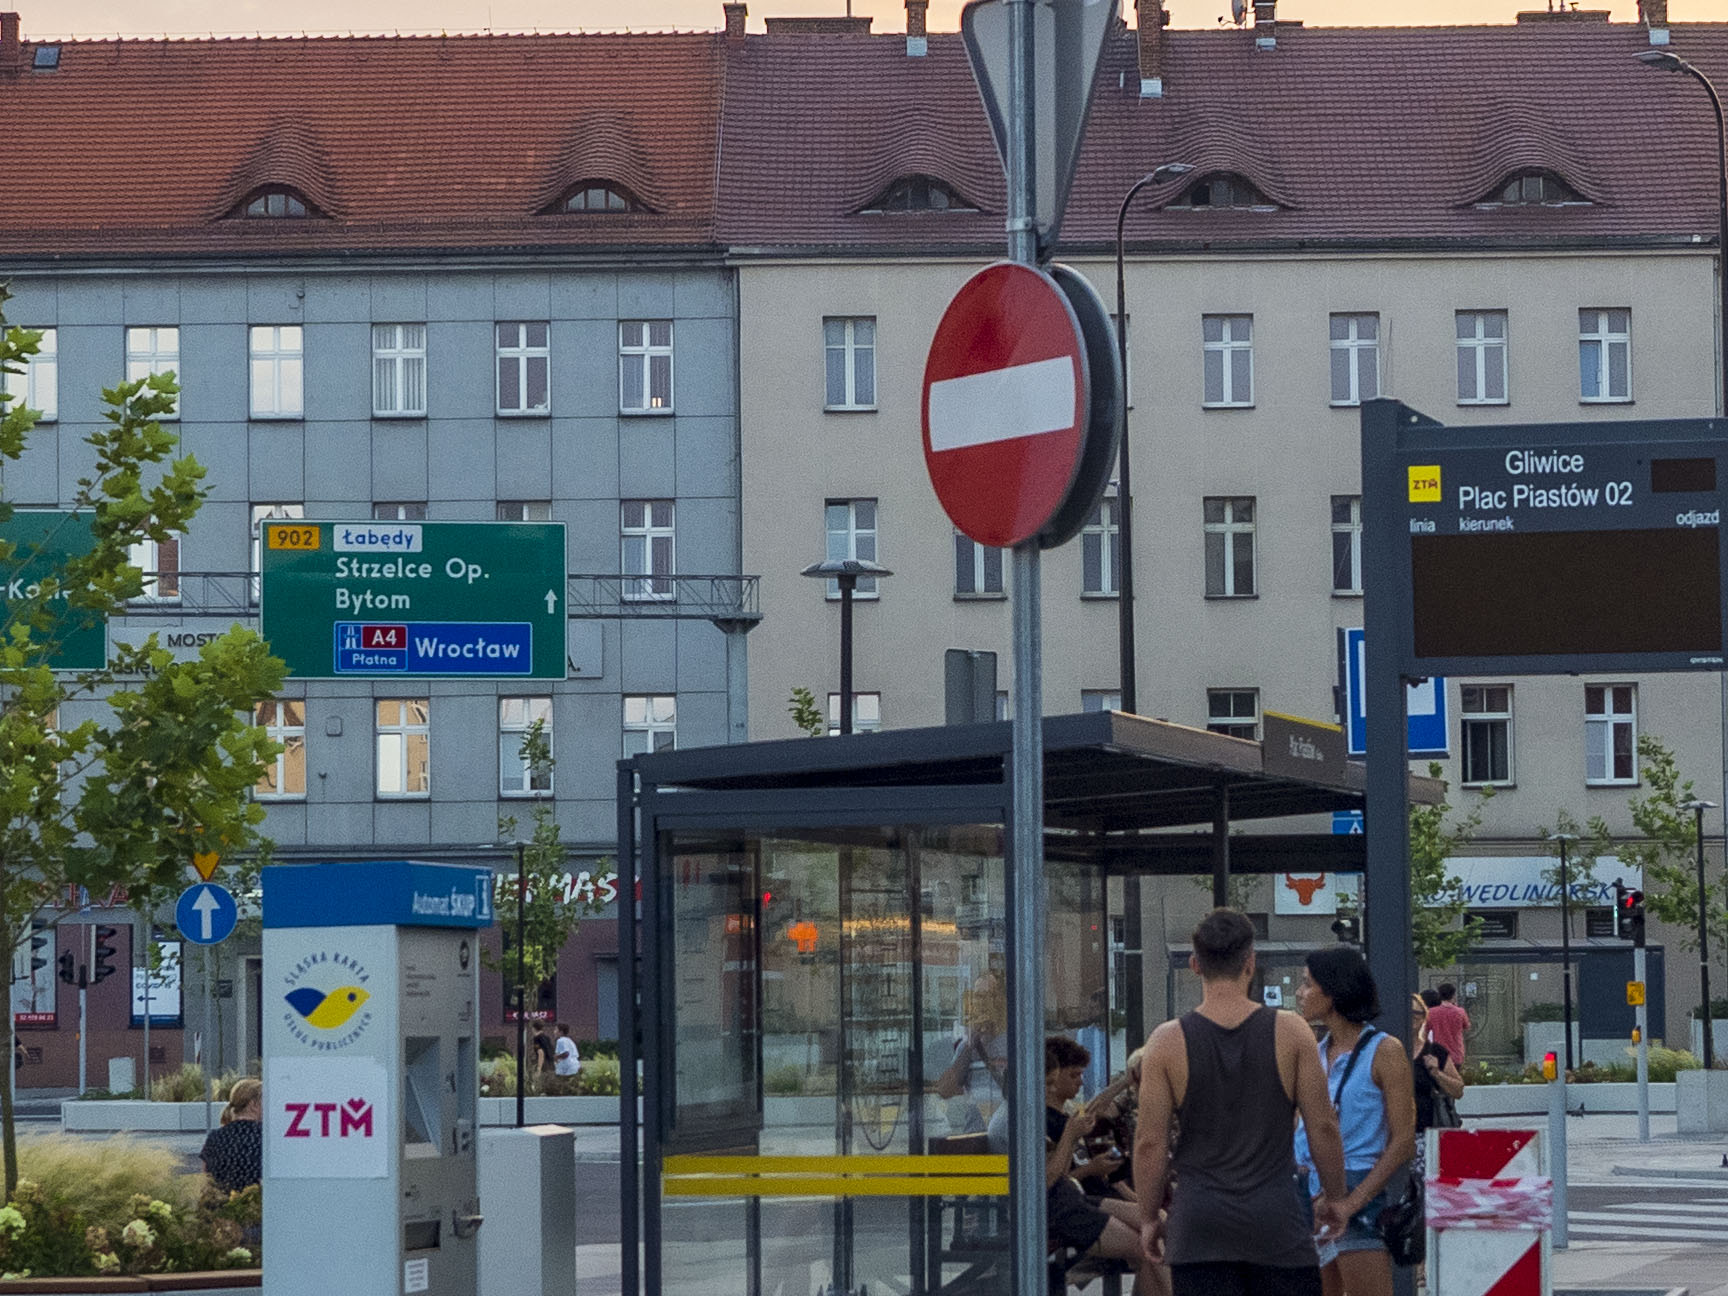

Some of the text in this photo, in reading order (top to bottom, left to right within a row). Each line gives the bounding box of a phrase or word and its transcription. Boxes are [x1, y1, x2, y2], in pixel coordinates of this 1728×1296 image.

[1505, 450, 1584, 475] Gliwice
[1458, 482, 1633, 510] Plac Piastów 02
[1410, 509, 1720, 533] linia kierunek odjazd
[277, 528, 414, 550] 902 Łabędy
[335, 557, 490, 584] Strzelce Op.
[335, 588, 411, 615] Bytom
[371, 629, 398, 646] A4
[415, 637, 520, 659] Wrocław
[352, 653, 397, 667] Płatna
[412, 890, 449, 916] Automat
[284, 951, 327, 986] ŚLĄSKA
[333, 951, 370, 984] KARTA
[284, 1012, 371, 1051] USŁUG PUBLICZNYCH
[284, 1097, 373, 1138] ZTM
